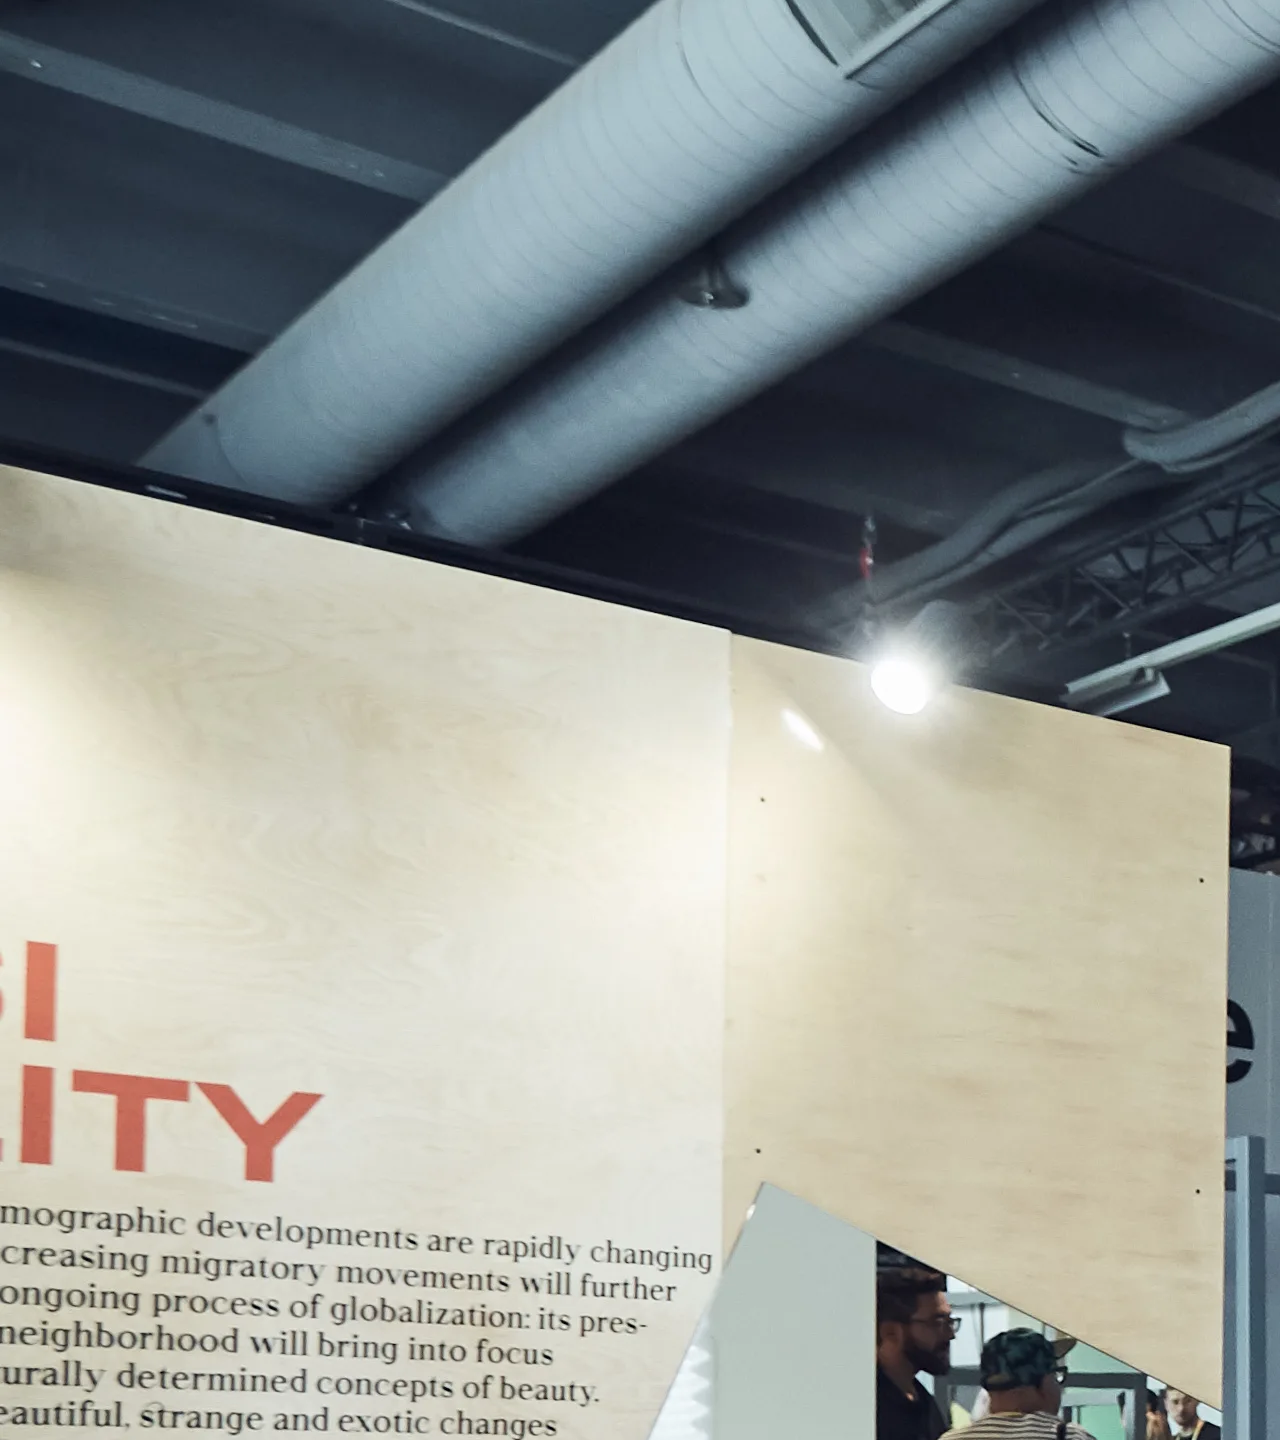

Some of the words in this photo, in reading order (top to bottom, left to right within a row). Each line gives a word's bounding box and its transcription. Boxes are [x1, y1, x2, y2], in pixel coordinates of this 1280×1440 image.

[0, 940, 58, 1042] I
[0, 1064, 325, 1183] ITY
[195, 1211, 421, 1252] developments
[426, 1233, 474, 1255] are
[483, 1235, 582, 1266] rapidly
[589, 1239, 713, 1275] changing
[0, 1243, 150, 1278] creasing
[160, 1249, 326, 1287] migratory
[336, 1265, 511, 1293] movements
[519, 1271, 572, 1296] will
[580, 1272, 678, 1302] further
[0, 1282, 142, 1317] ongoing
[151, 1293, 281, 1318] process
[288, 1292, 325, 1319] of
[329, 1295, 531, 1330] globalization:
[537, 1306, 572, 1332] its
[579, 1315, 648, 1338] pres-
[249, 1329, 308, 1357] will
[317, 1330, 399, 1366] bring
[408, 1336, 468, 1363] into
[475, 1337, 554, 1366] focus
[115, 1361, 308, 1394] determined
[315, 1376, 455, 1404] concepts
[461, 1374, 495, 1400] of
[499, 1375, 600, 1408] beauty.
[138, 1401, 264, 1437] strange
[272, 1406, 330, 1432] and
[336, 1409, 430, 1435] exotic
